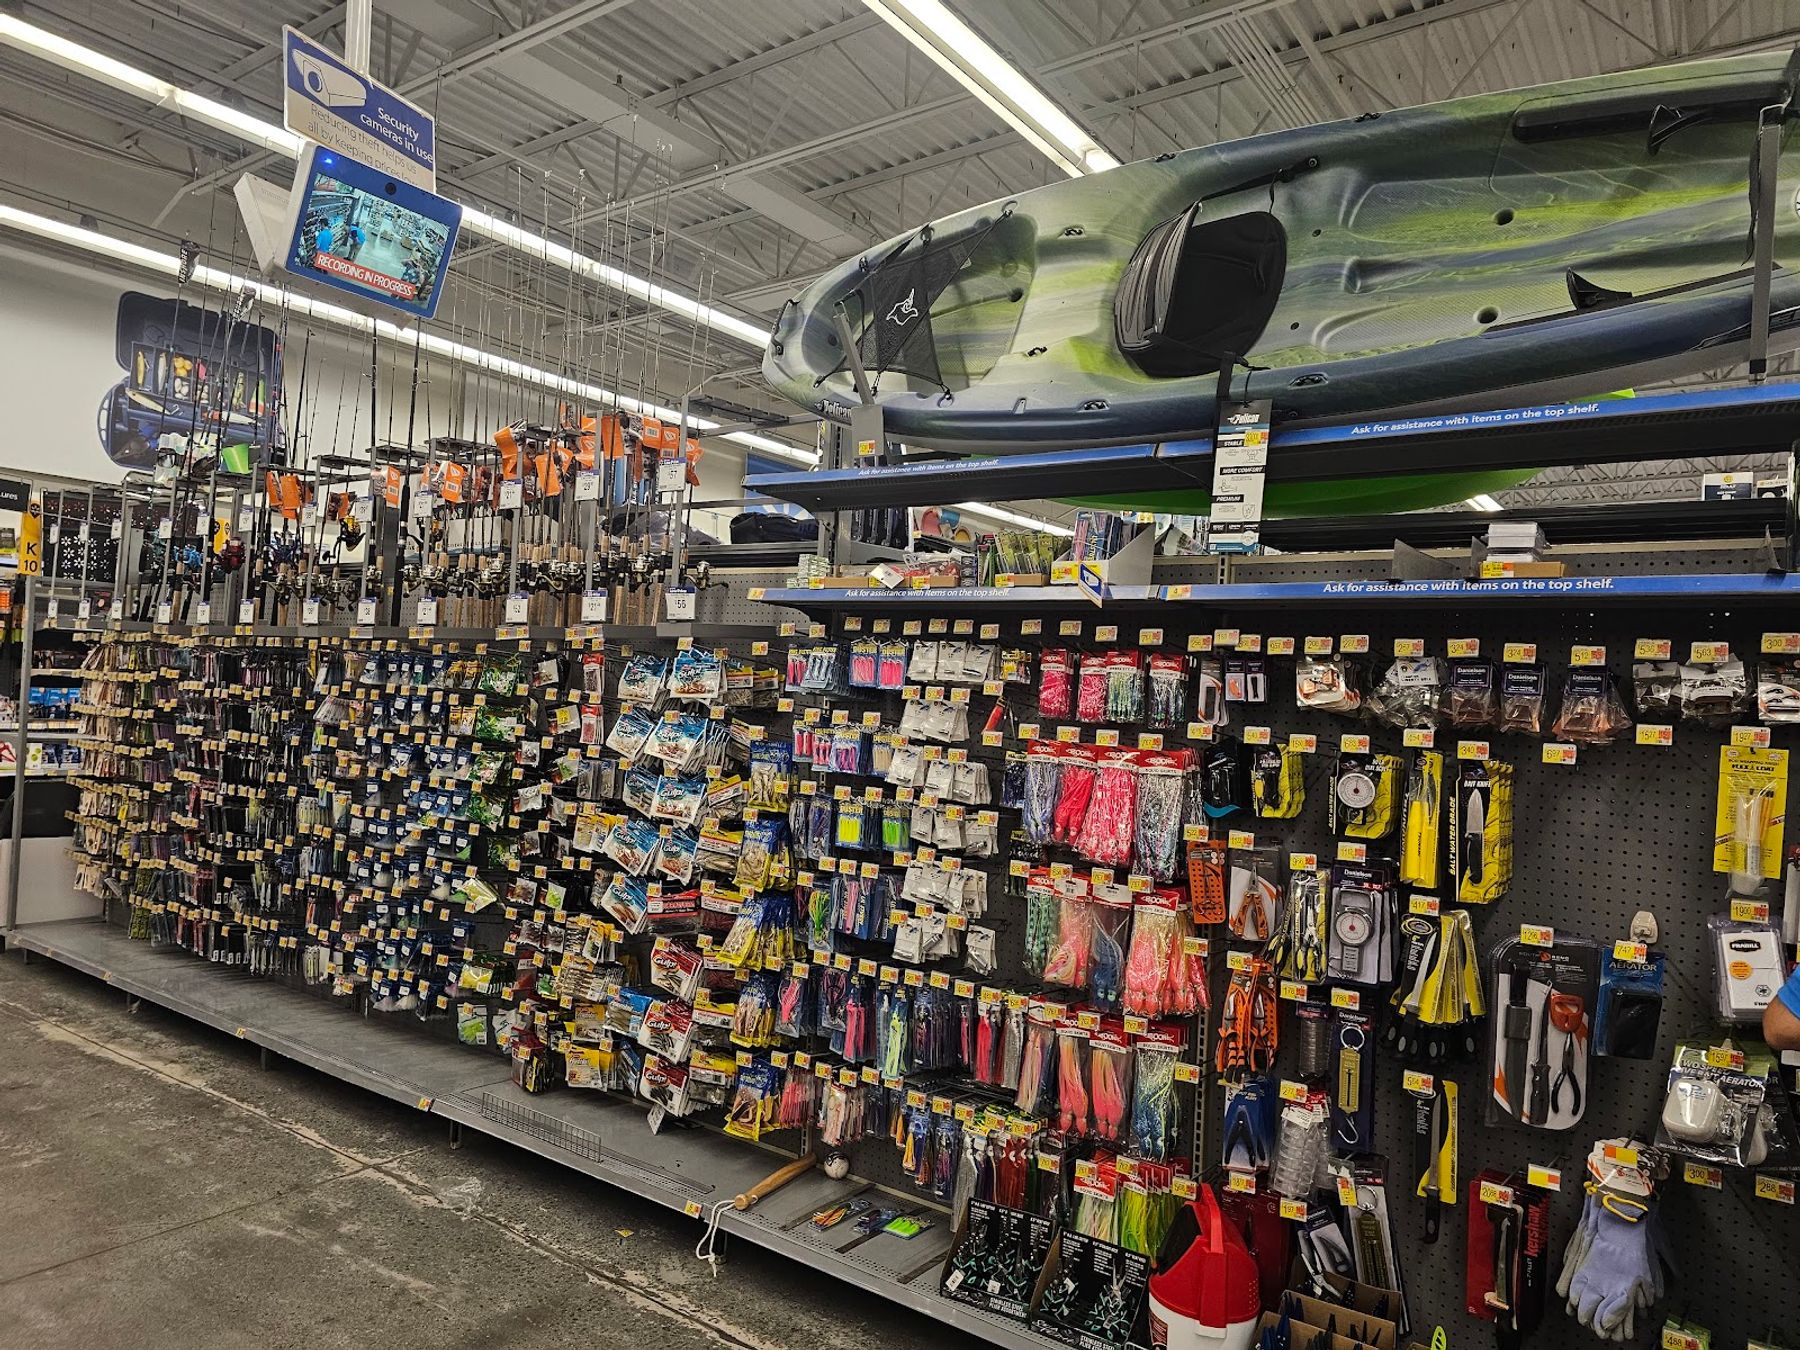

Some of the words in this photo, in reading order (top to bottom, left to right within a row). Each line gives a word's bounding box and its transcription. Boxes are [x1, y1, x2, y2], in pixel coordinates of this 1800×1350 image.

[378, 108, 418, 142] Security
[308, 121, 320, 134] all
[321, 128, 334, 144] by
[336, 136, 374, 166] keeping
[311, 103, 356, 142] Reducing
[358, 132, 381, 154] theft
[382, 147, 404, 169] helps
[406, 161, 417, 175] us
[360, 112, 402, 146] cameras
[404, 138, 415, 154] in
[416, 146, 433, 164] use
[318, 254, 364, 281] RECORDING
[364, 270, 372, 284] IN
[374, 274, 413, 297] PROGRESS
[1230, 413, 1260, 424] Pelican
[1351, 426, 1371, 435] Ask
[1373, 424, 1390, 433] for
[1390, 418, 1442, 432] assistance
[1446, 416, 1469, 426] with
[1472, 412, 1502, 424] items
[1504, 412, 1519, 420] on
[1522, 408, 1541, 419] the
[1544, 408, 1564, 419] top
[1568, 403, 1600, 415] shelf.
[0, 492, 18, 500] ures
[26, 542, 37, 556] K
[24, 560, 38, 572] 10
[870, 589, 906, 597] assistance
[907, 589, 924, 597] with
[925, 589, 946, 597] items
[958, 588, 972, 597] the
[974, 590, 988, 598] top
[1323, 582, 1345, 593] Ask
[1347, 582, 1364, 592] for
[1366, 581, 1428, 592] assistance
[1430, 580, 1460, 592] with
[1462, 580, 1499, 591] items
[1502, 581, 1518, 590] on
[1522, 579, 1545, 590] the
[1548, 580, 1573, 592] top
[1576, 578, 1614, 590] shelf.
[1608, 962, 1658, 972] AERATOR
[647, 1020, 671, 1030] Gulp!
[1524, 1204, 1540, 1258] kershaw
